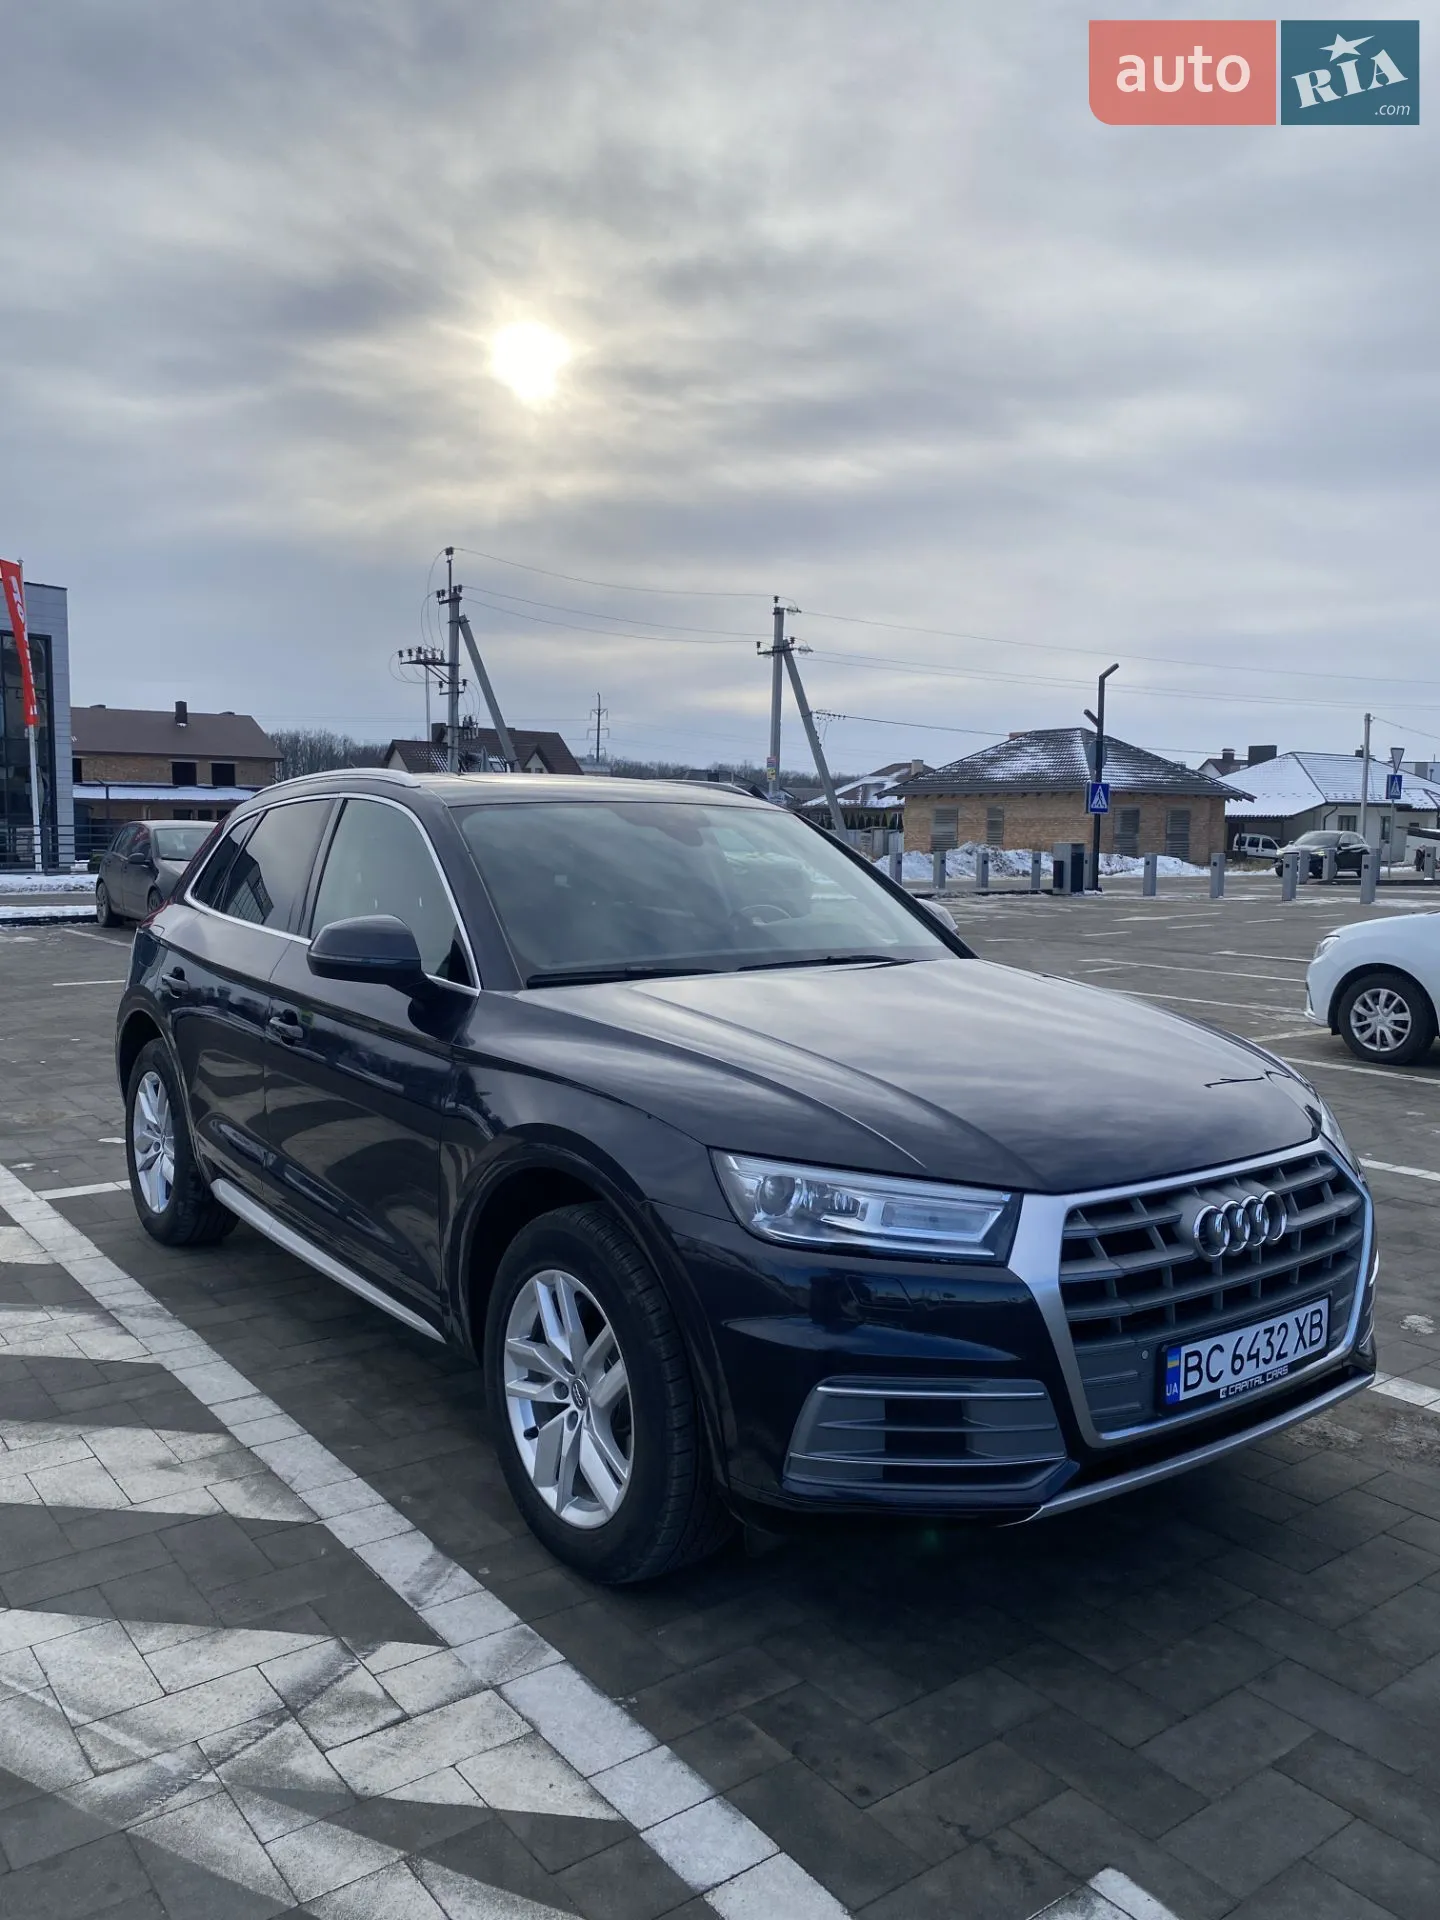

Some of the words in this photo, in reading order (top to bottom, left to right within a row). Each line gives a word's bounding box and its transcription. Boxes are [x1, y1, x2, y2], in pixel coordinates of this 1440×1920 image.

[1166, 1383, 1179, 1396] UA
[1228, 1376, 1265, 1395] CAPITAL
[1266, 1365, 1288, 1381] CARS
